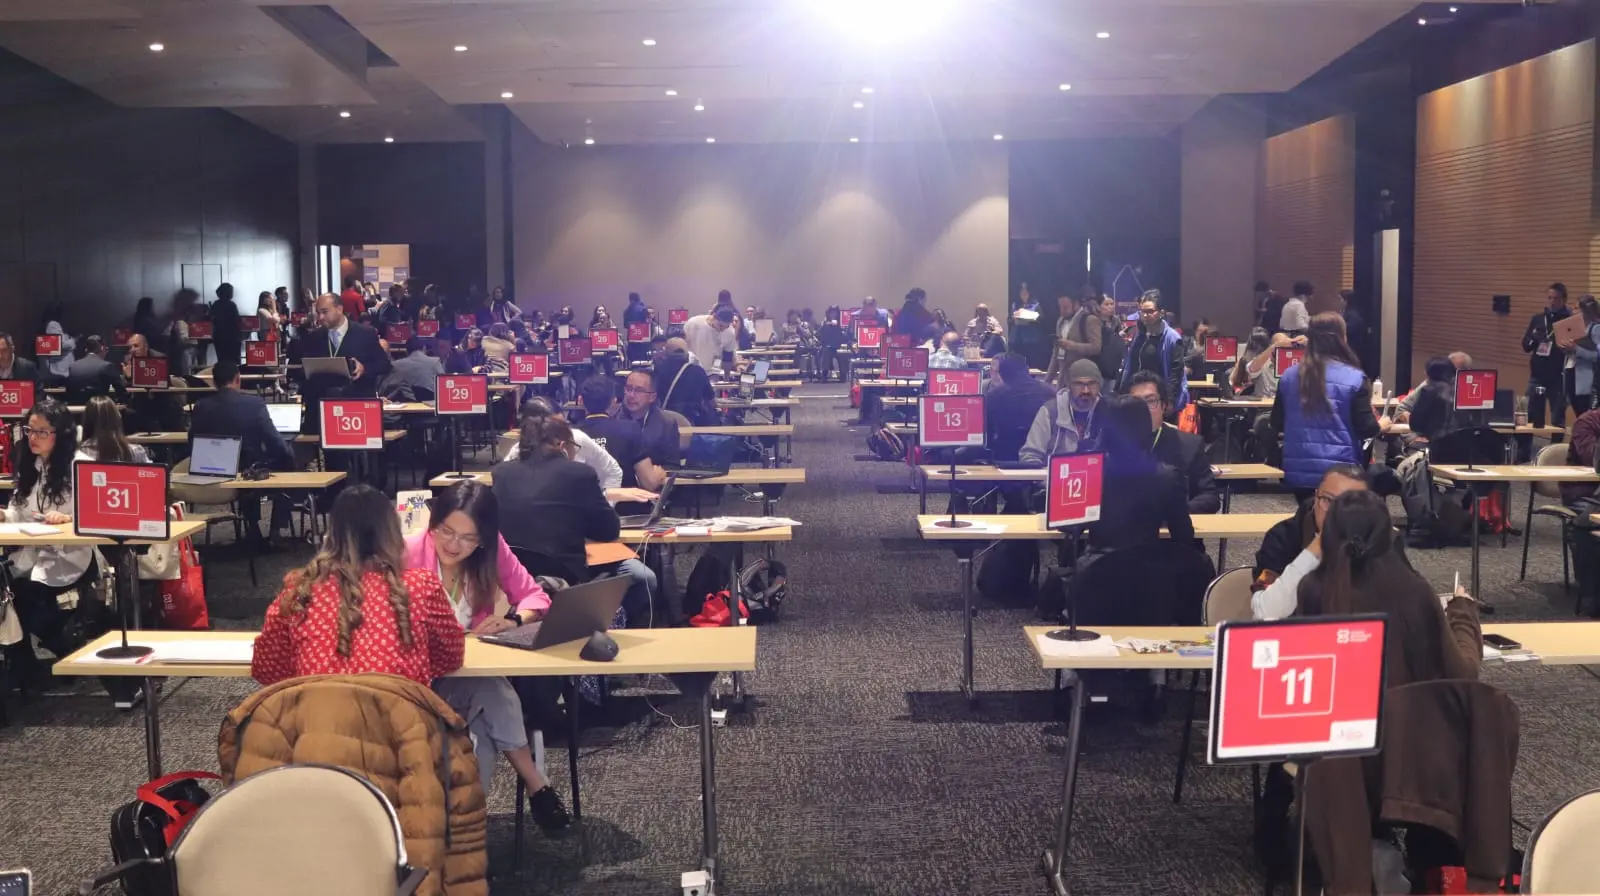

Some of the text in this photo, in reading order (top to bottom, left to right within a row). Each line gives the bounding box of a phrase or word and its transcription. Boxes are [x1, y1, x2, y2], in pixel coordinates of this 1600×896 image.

[253, 350, 264, 358] 40
[144, 367, 156, 377] 39
[519, 363, 532, 373] 28
[451, 388, 469, 400] 29
[944, 383, 958, 394] 14
[1471, 383, 1478, 395] 7
[1, 392, 18, 404] 38
[341, 416, 362, 431] 30
[944, 412, 961, 427] 13
[1067, 478, 1082, 498] 12
[106, 488, 130, 509] 31
[1281, 667, 1313, 705] 11
